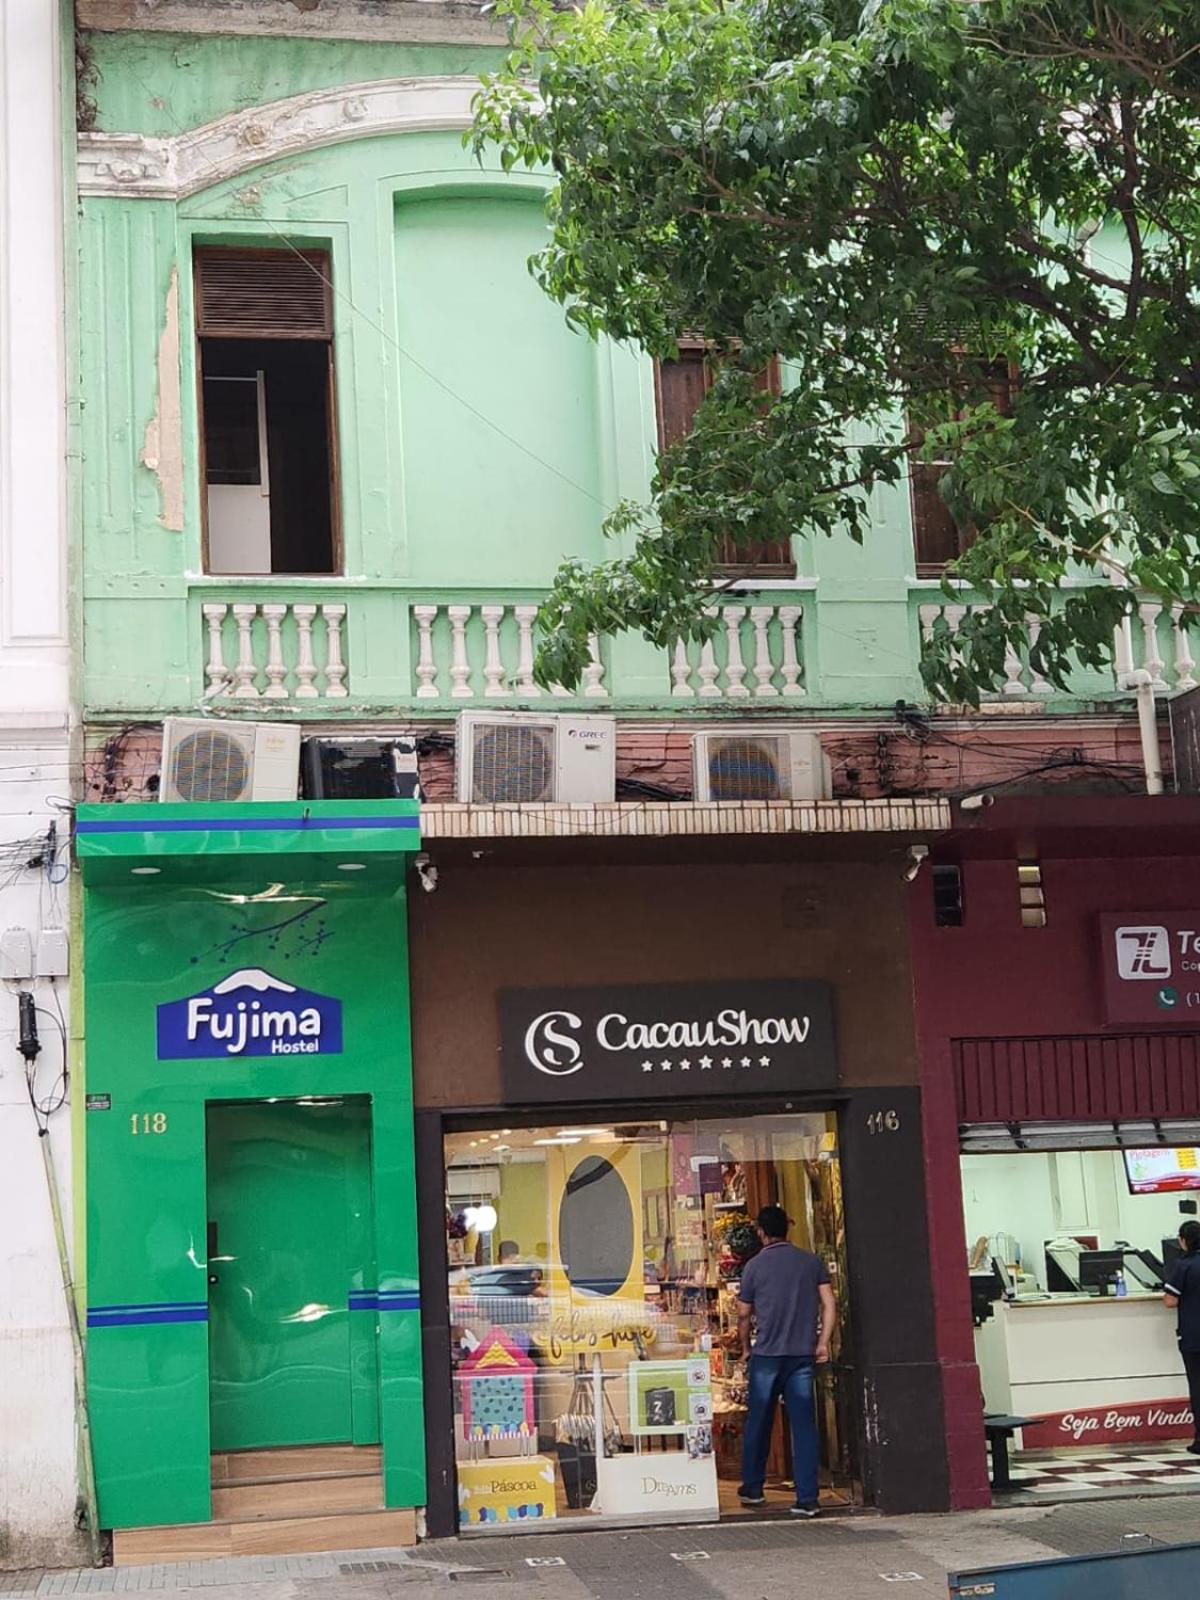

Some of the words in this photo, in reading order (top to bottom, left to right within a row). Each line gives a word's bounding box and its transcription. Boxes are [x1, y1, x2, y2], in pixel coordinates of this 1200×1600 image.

[187, 998, 321, 1053] Fujima
[271, 1038, 319, 1054] Hostel
[130, 1112, 167, 1135] 118
[867, 1110, 900, 1135] 116
[1059, 1413, 1099, 1440] Seja
[1103, 1411, 1142, 1432] Bem
[1147, 1407, 1194, 1426] Vindo
